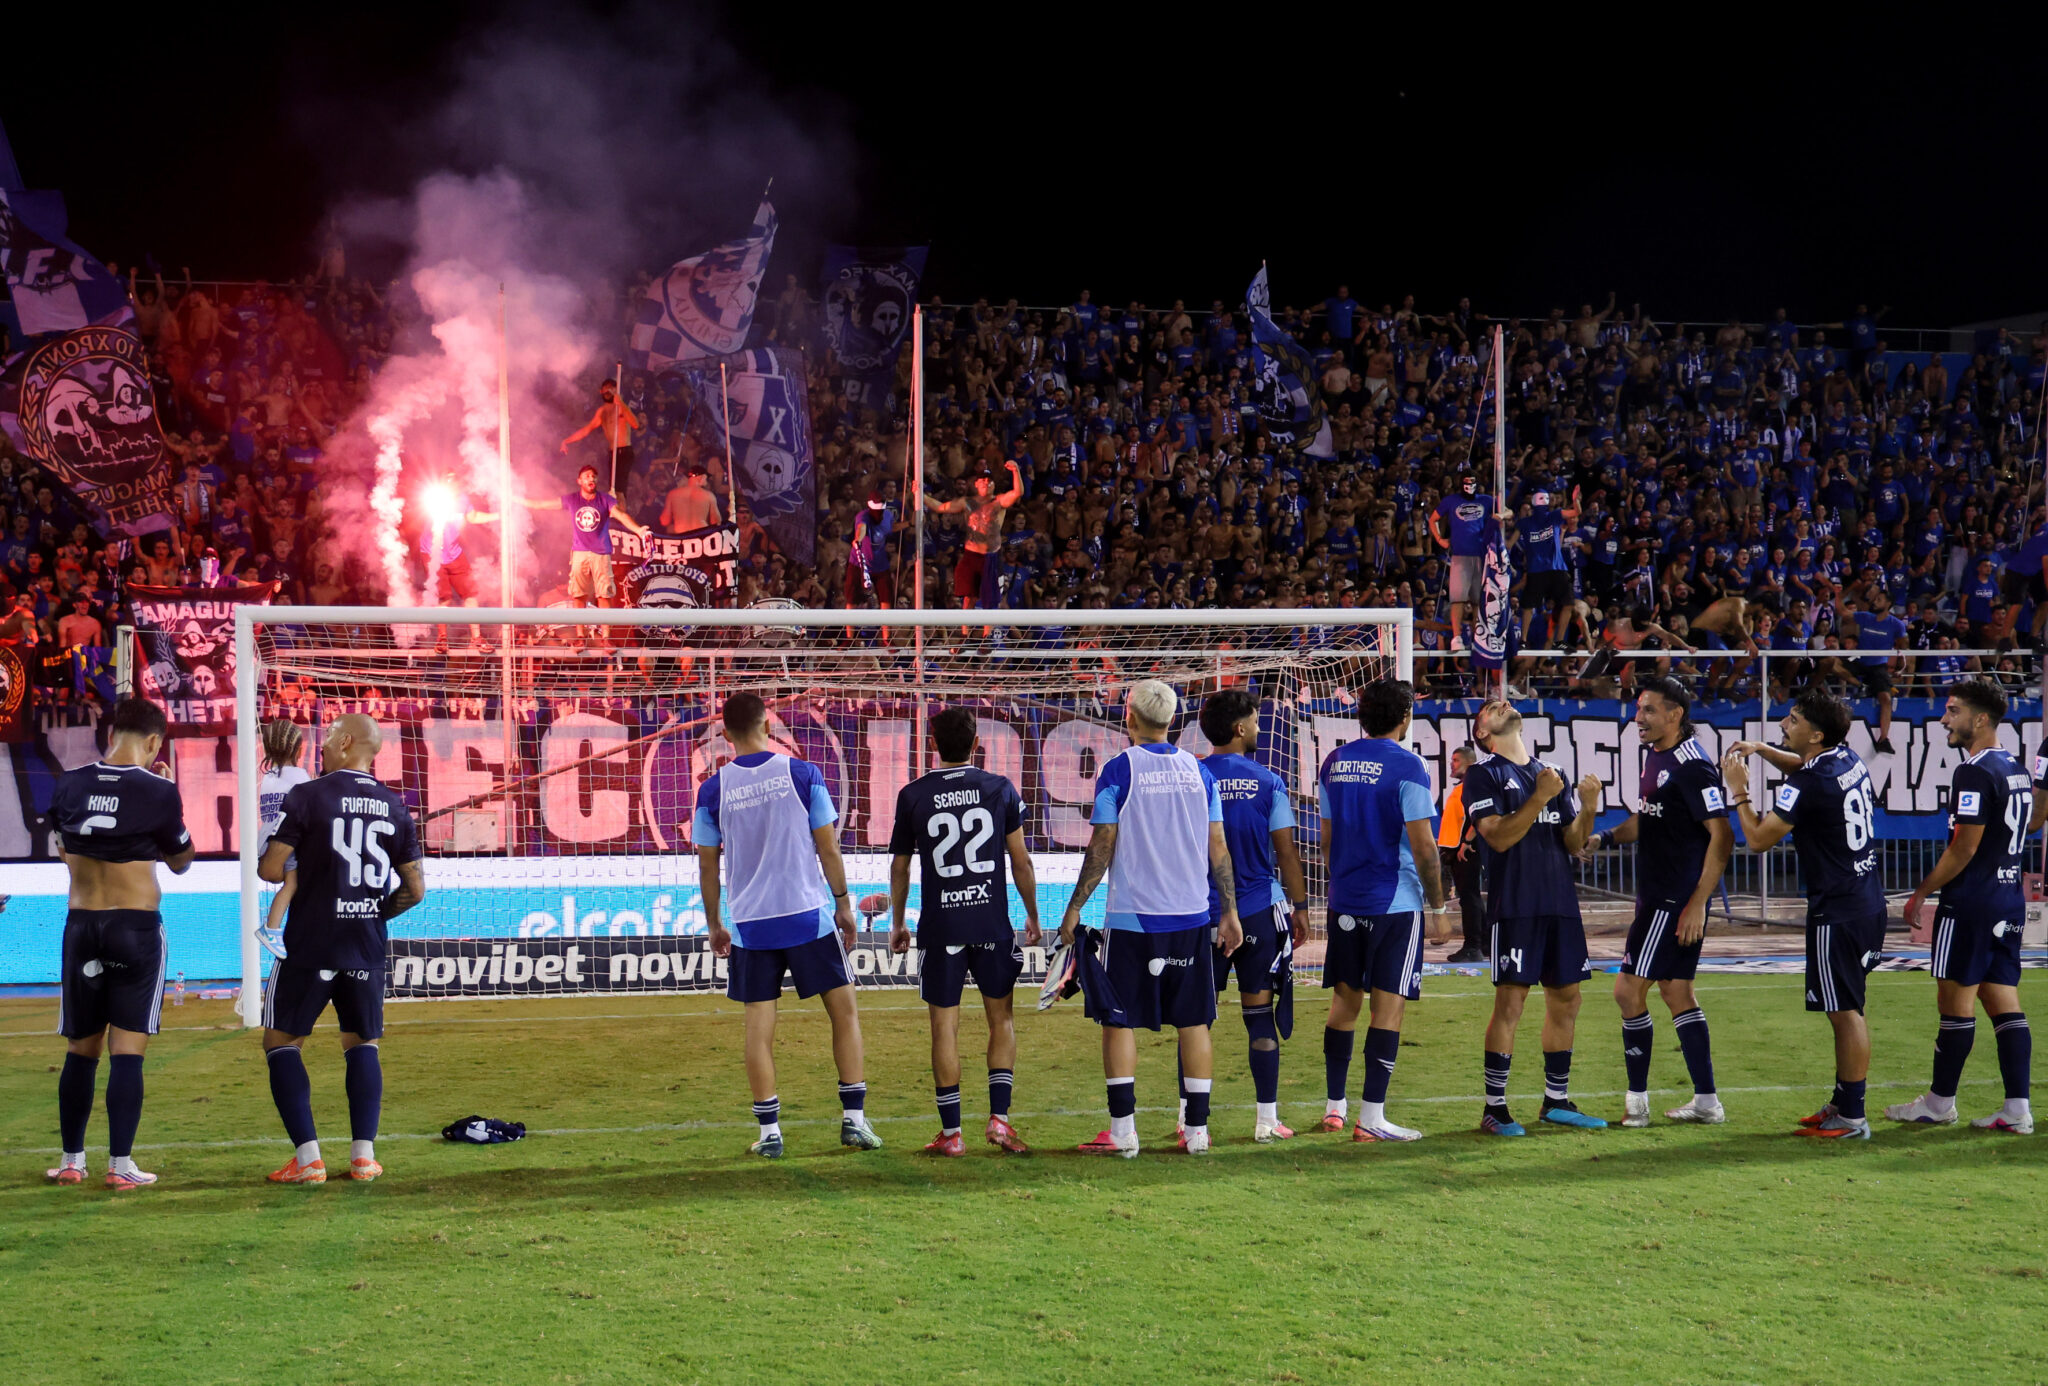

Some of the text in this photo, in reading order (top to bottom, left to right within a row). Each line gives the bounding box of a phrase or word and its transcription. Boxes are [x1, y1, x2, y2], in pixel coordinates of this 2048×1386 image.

[676, 564, 709, 585] BOYS
[1138, 771, 1200, 785] ANORTHOSIS
[1217, 778, 1259, 792] RTHOSIS
[725, 775, 791, 803] ANORTHOSIS
[933, 789, 980, 809] SERGIOU
[87, 795, 119, 813] KIKO
[341, 796, 390, 818] FURTADO
[2004, 791, 2034, 855] 47
[332, 817, 395, 889] 45
[927, 807, 995, 878] 22
[940, 883, 989, 903] IronFX
[336, 898, 382, 913] IronFX
[393, 941, 729, 987] novibet novi
[1510, 948, 1523, 974] 4
